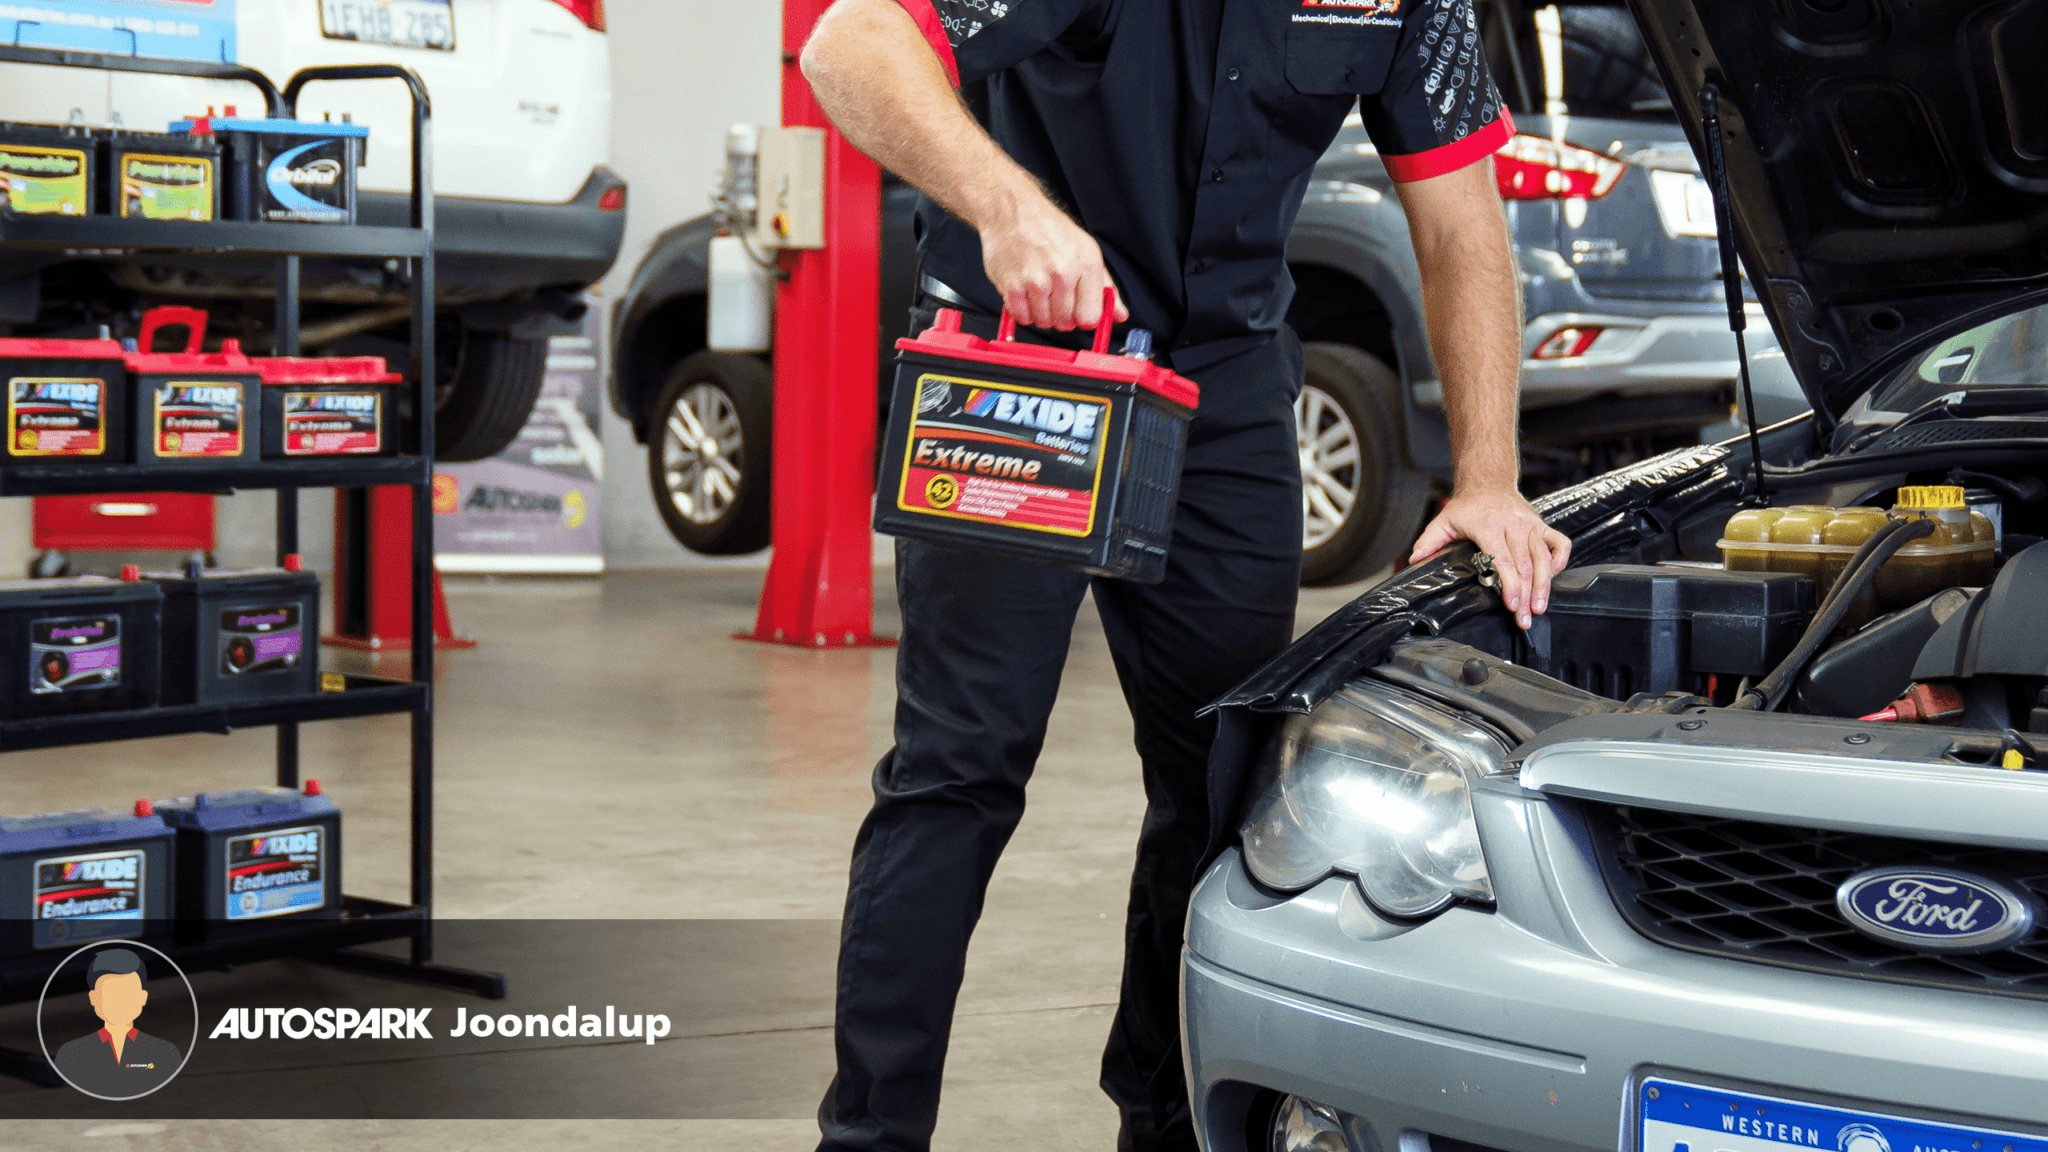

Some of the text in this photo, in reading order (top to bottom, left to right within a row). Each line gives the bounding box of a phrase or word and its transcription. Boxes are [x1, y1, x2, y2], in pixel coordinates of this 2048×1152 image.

[270, 166, 336, 184] Orbital
[50, 384, 98, 402] EXIDE
[192, 386, 238, 405] EXIDE
[325, 395, 374, 411] EXIDE
[993, 391, 1099, 440] EXIDE
[1035, 431, 1091, 455] Batteries
[912, 438, 1043, 481] Extreme
[269, 832, 318, 855] EXIDE
[82, 858, 137, 881] EXIDE
[233, 869, 310, 892] Endurance
[41, 896, 128, 919] Endurance
[1874, 878, 1982, 931] Ford
[1721, 1113, 1820, 1146] WESTERN
